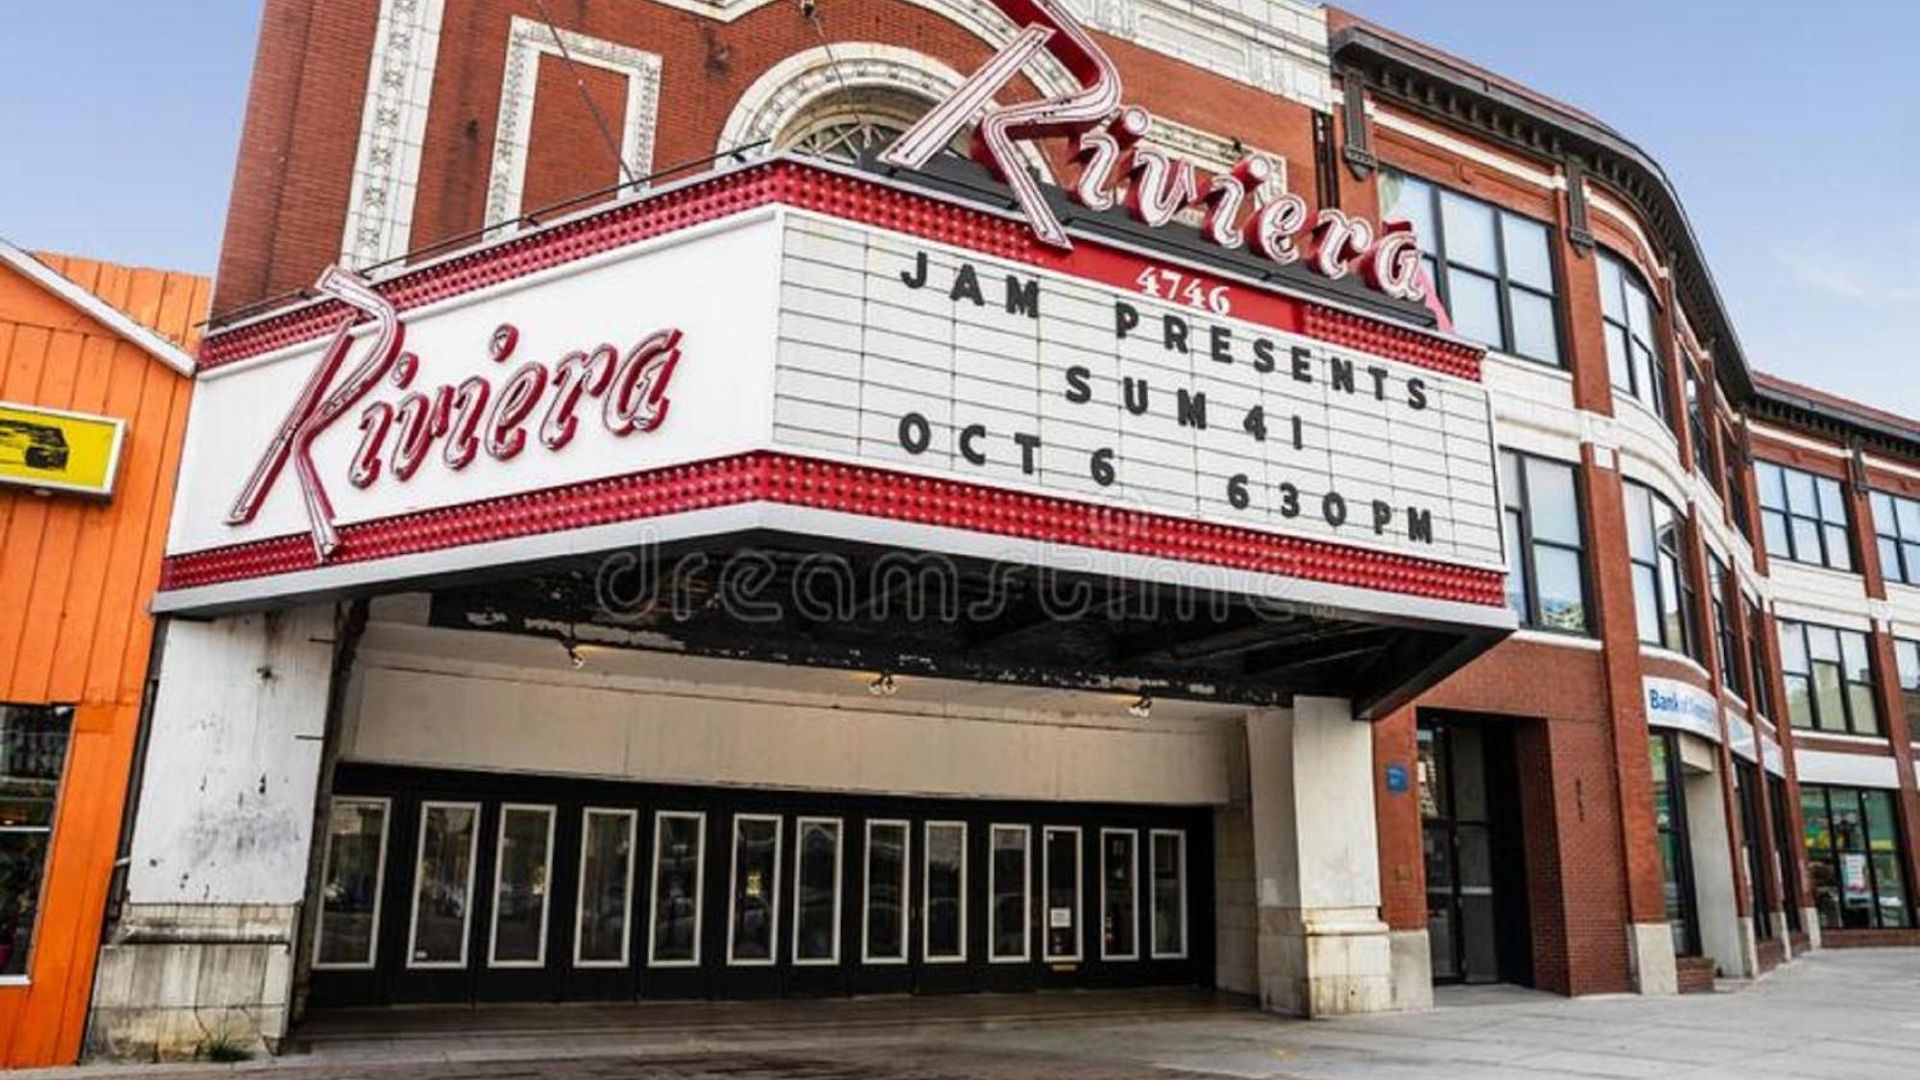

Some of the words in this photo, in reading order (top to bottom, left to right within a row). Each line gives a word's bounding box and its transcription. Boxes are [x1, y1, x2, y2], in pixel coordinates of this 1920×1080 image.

[879, 0, 1432, 301] Riviera
[901, 251, 1040, 319] JAM
[1115, 301, 1427, 410] PRESENTS
[1137, 267, 1231, 317] 4746
[222, 264, 684, 565] Riviera
[900, 412, 1042, 475] OCT
[1090, 448, 1116, 486] 6
[1227, 473, 1434, 545] 630PM
[1649, 688, 1680, 712] Bank
